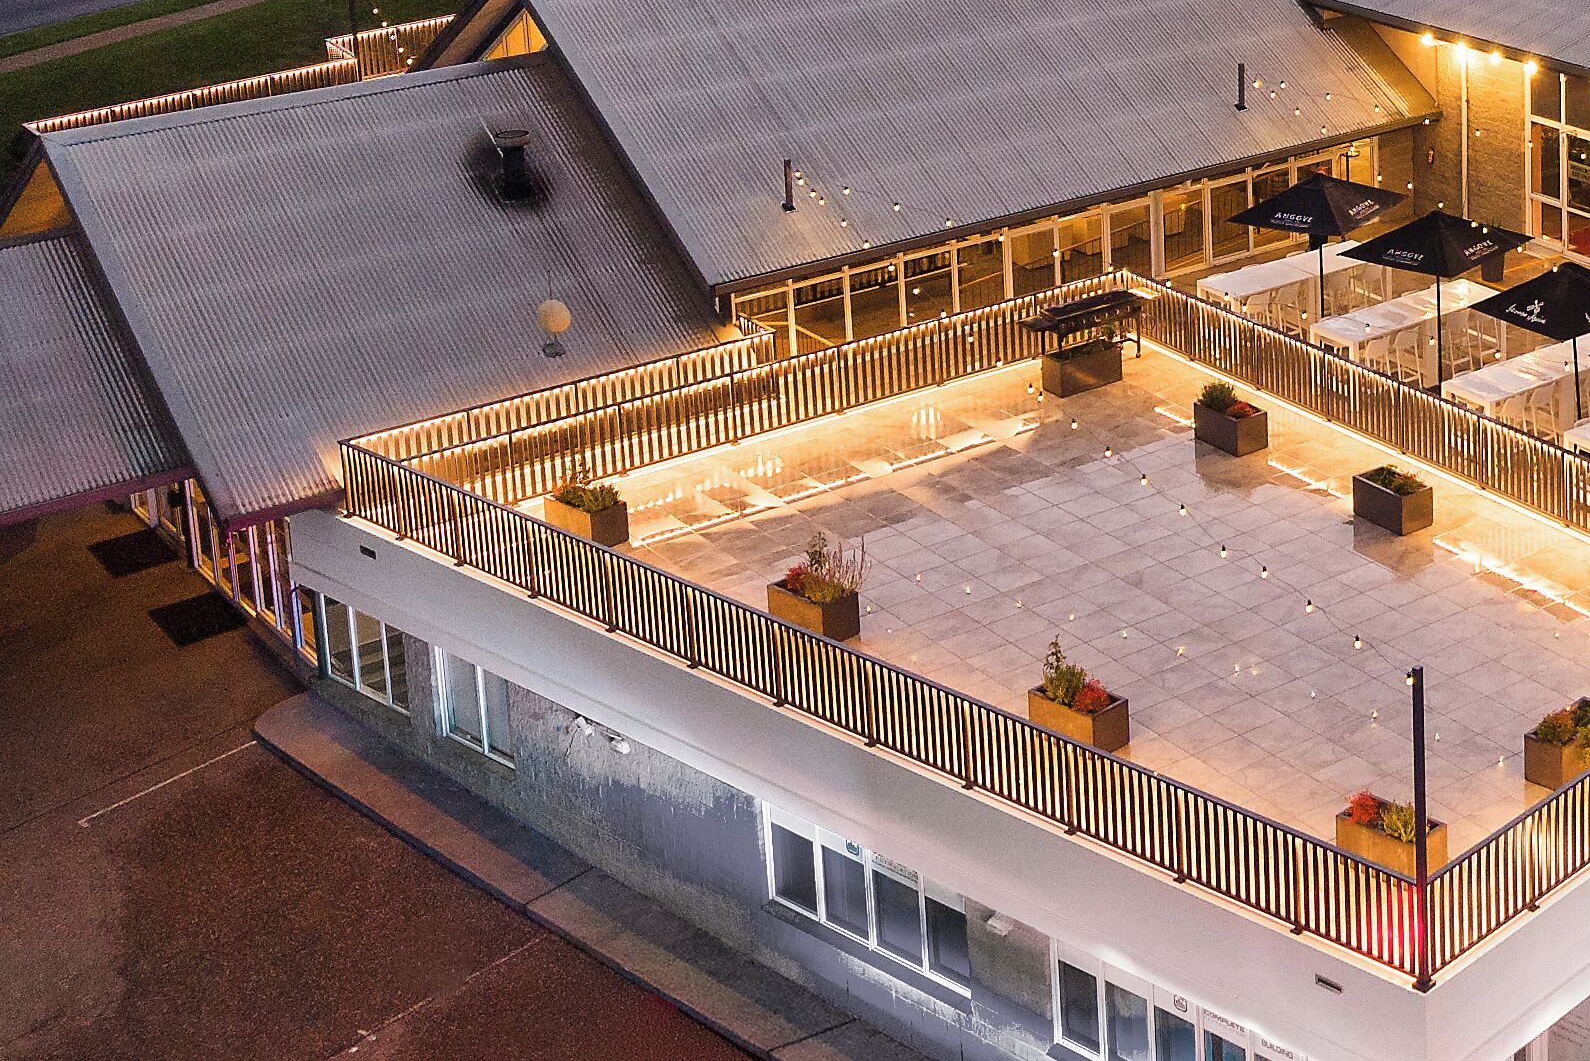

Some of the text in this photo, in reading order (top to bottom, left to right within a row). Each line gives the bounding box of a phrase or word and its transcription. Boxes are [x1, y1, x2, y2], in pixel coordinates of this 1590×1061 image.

[1348, 199, 1375, 216] ANGOVE
[1274, 212, 1314, 223] ANGOVE
[1387, 248, 1425, 261] ANGOVE
[1463, 239, 1494, 257] ANGOVE
[1203, 1008, 1245, 1032] COMPLETE
[1261, 1038, 1293, 1059] BUILDING
